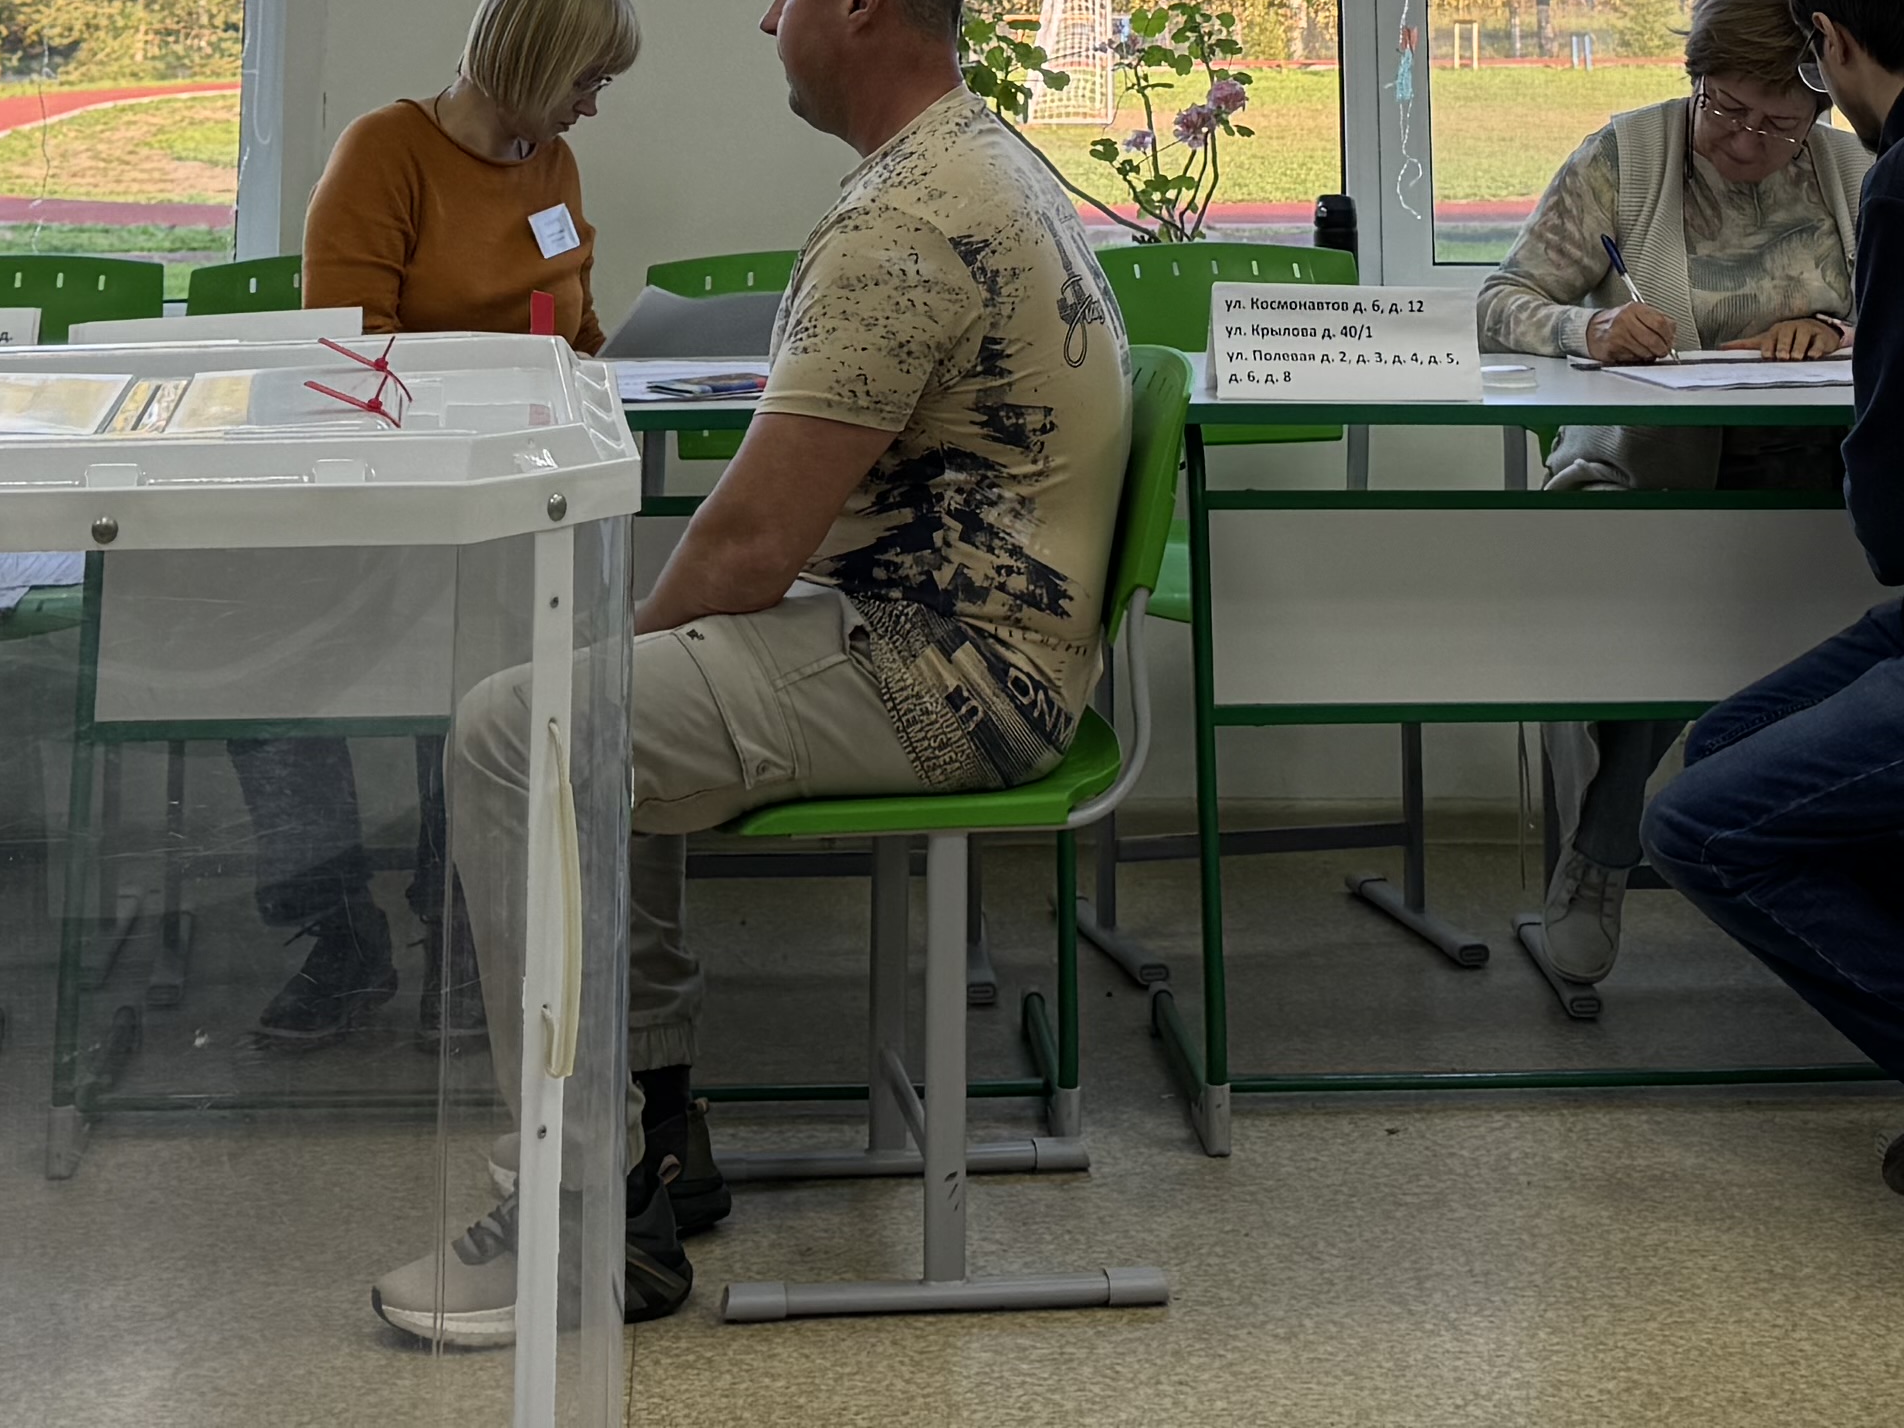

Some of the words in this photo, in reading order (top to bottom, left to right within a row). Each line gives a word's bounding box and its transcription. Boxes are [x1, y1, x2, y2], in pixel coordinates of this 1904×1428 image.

[1225, 299, 1246, 312] ул.
[1251, 297, 1349, 312] Космонавтов
[1353, 301, 1367, 314] д.
[1372, 300, 1384, 314] 6,
[1388, 302, 1402, 314] д.
[1408, 300, 1424, 312] 12
[1225, 325, 1246, 338] ул.
[1251, 324, 1317, 339] Крылова
[1321, 326, 1336, 340] д.
[1340, 324, 1373, 340] 40/1
[1226, 351, 1248, 363] ул.
[1253, 350, 1316, 362] Полевая
[1320, 353, 1335, 364] д.
[1339, 351, 1351, 364] 2,
[1356, 353, 1370, 364] д.
[1374, 352, 1387, 364] 3,
[1392, 354, 1406, 365] д.
[1411, 352, 1423, 366] 4,
[1428, 354, 1442, 366] д.
[1446, 353, 1459, 365] 5,
[1228, 372, 1242, 384] д.
[1247, 371, 1260, 384] 6,
[1264, 373, 1278, 384] д.
[1283, 371, 1292, 382] 8
